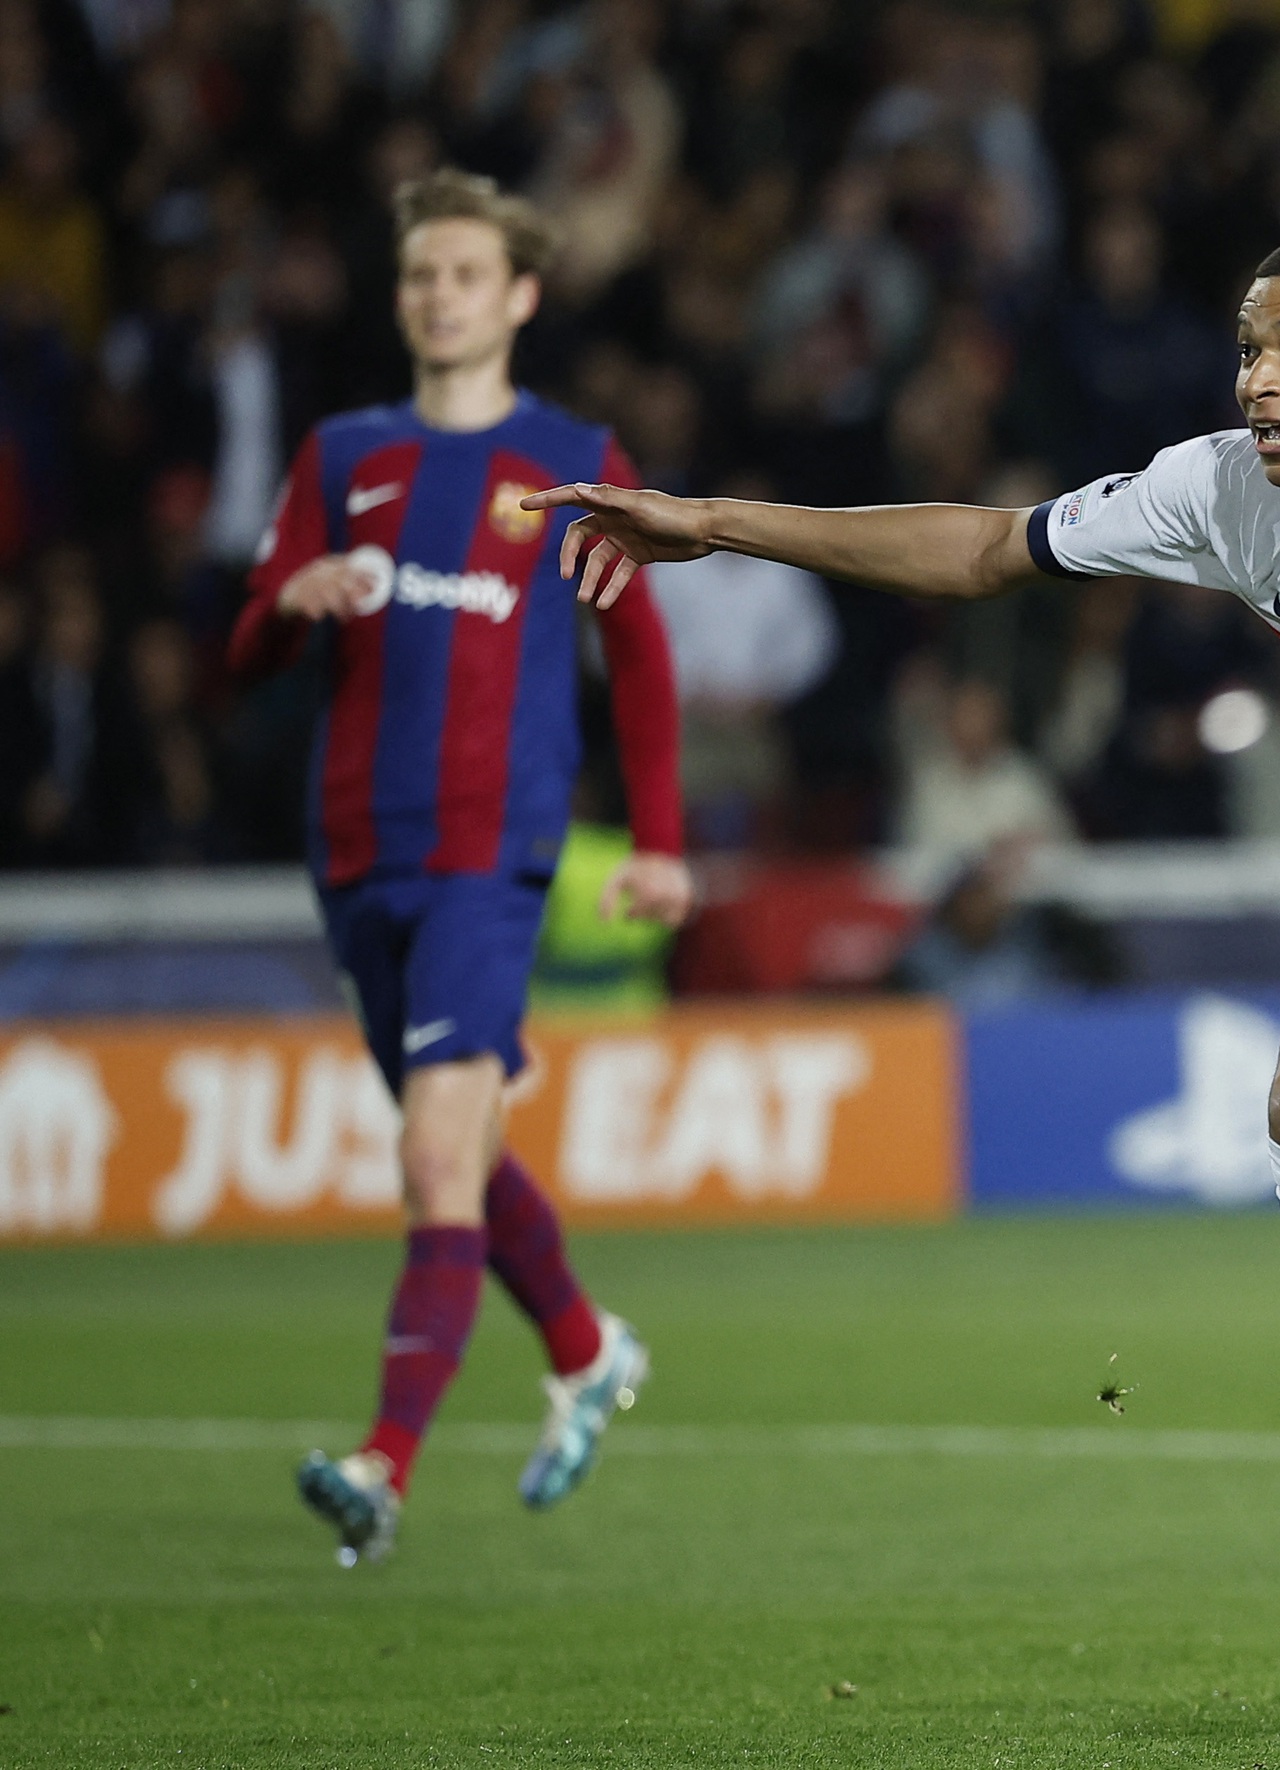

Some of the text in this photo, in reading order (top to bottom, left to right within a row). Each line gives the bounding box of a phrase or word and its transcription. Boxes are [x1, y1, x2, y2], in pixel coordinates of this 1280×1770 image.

[397, 562, 519, 623] Spotify
[155, 1033, 872, 1238] JUS EAT
